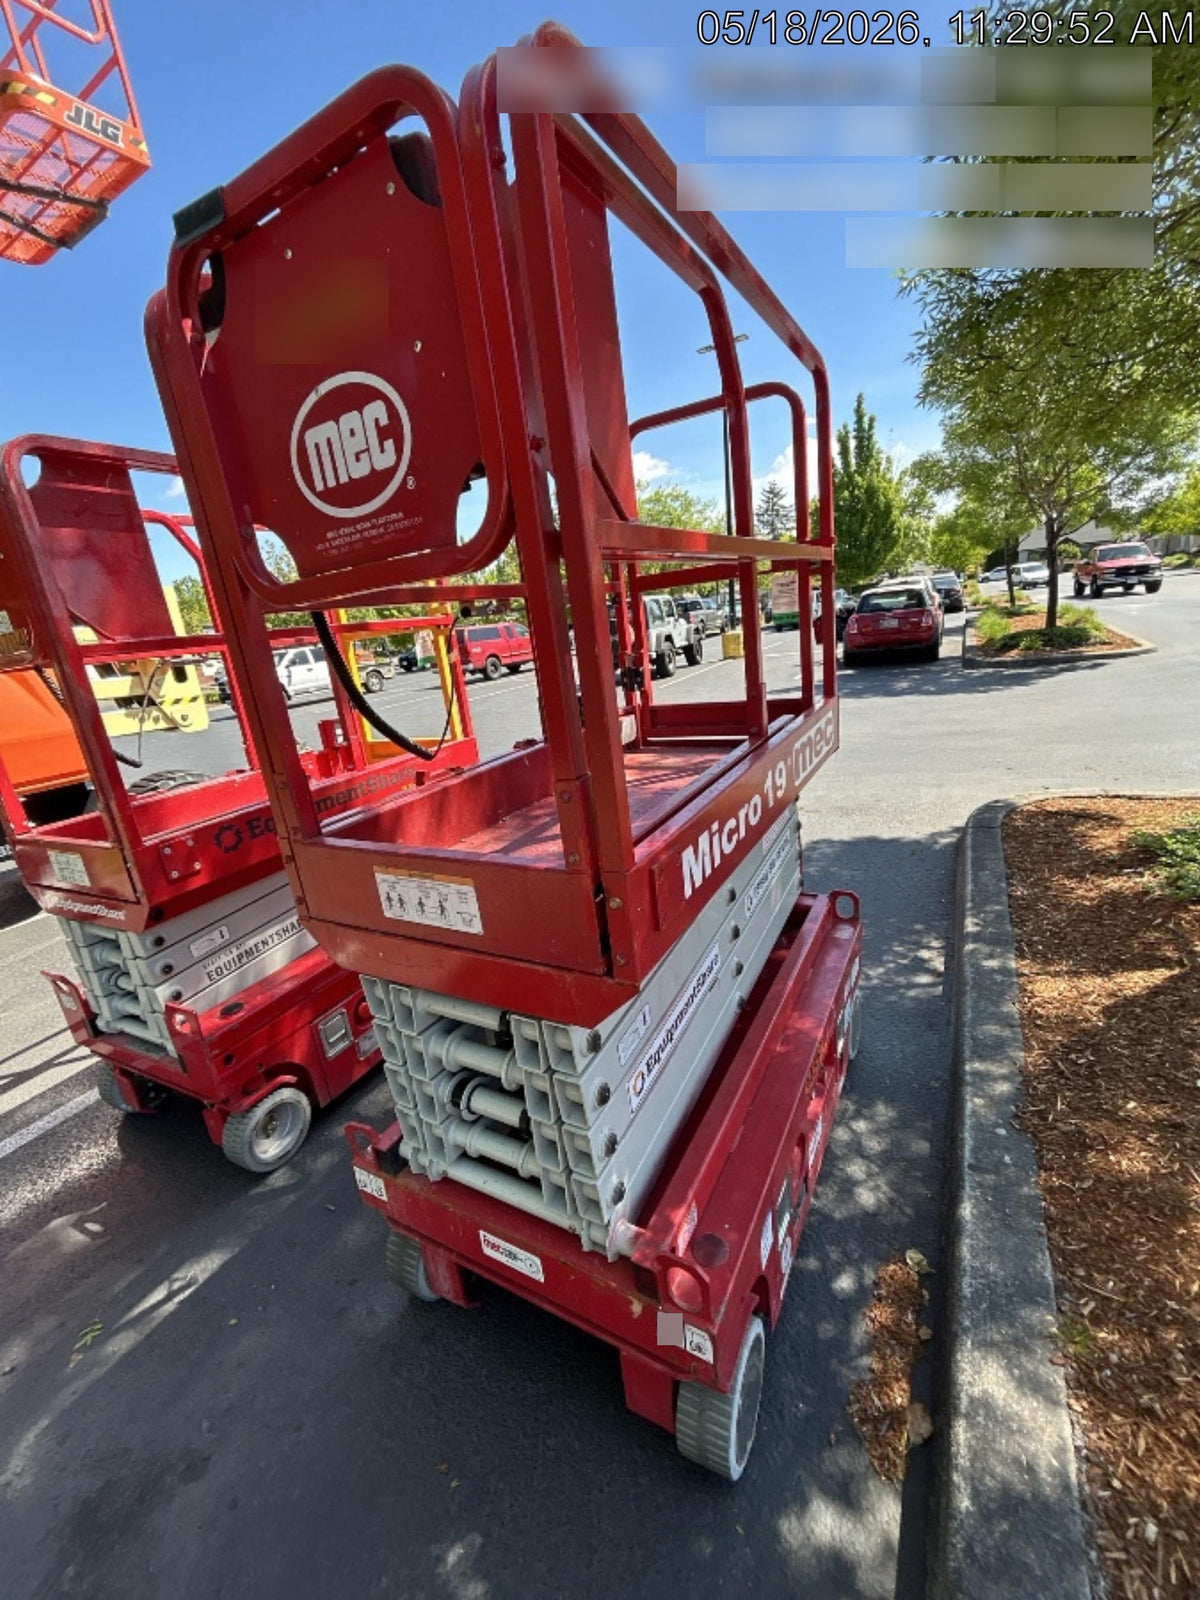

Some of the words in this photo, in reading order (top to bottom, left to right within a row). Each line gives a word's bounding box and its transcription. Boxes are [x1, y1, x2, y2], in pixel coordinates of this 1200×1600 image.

[65, 104, 122, 146] JLG
[681, 794, 762, 900] Micro
[764, 760, 787, 808] 19
